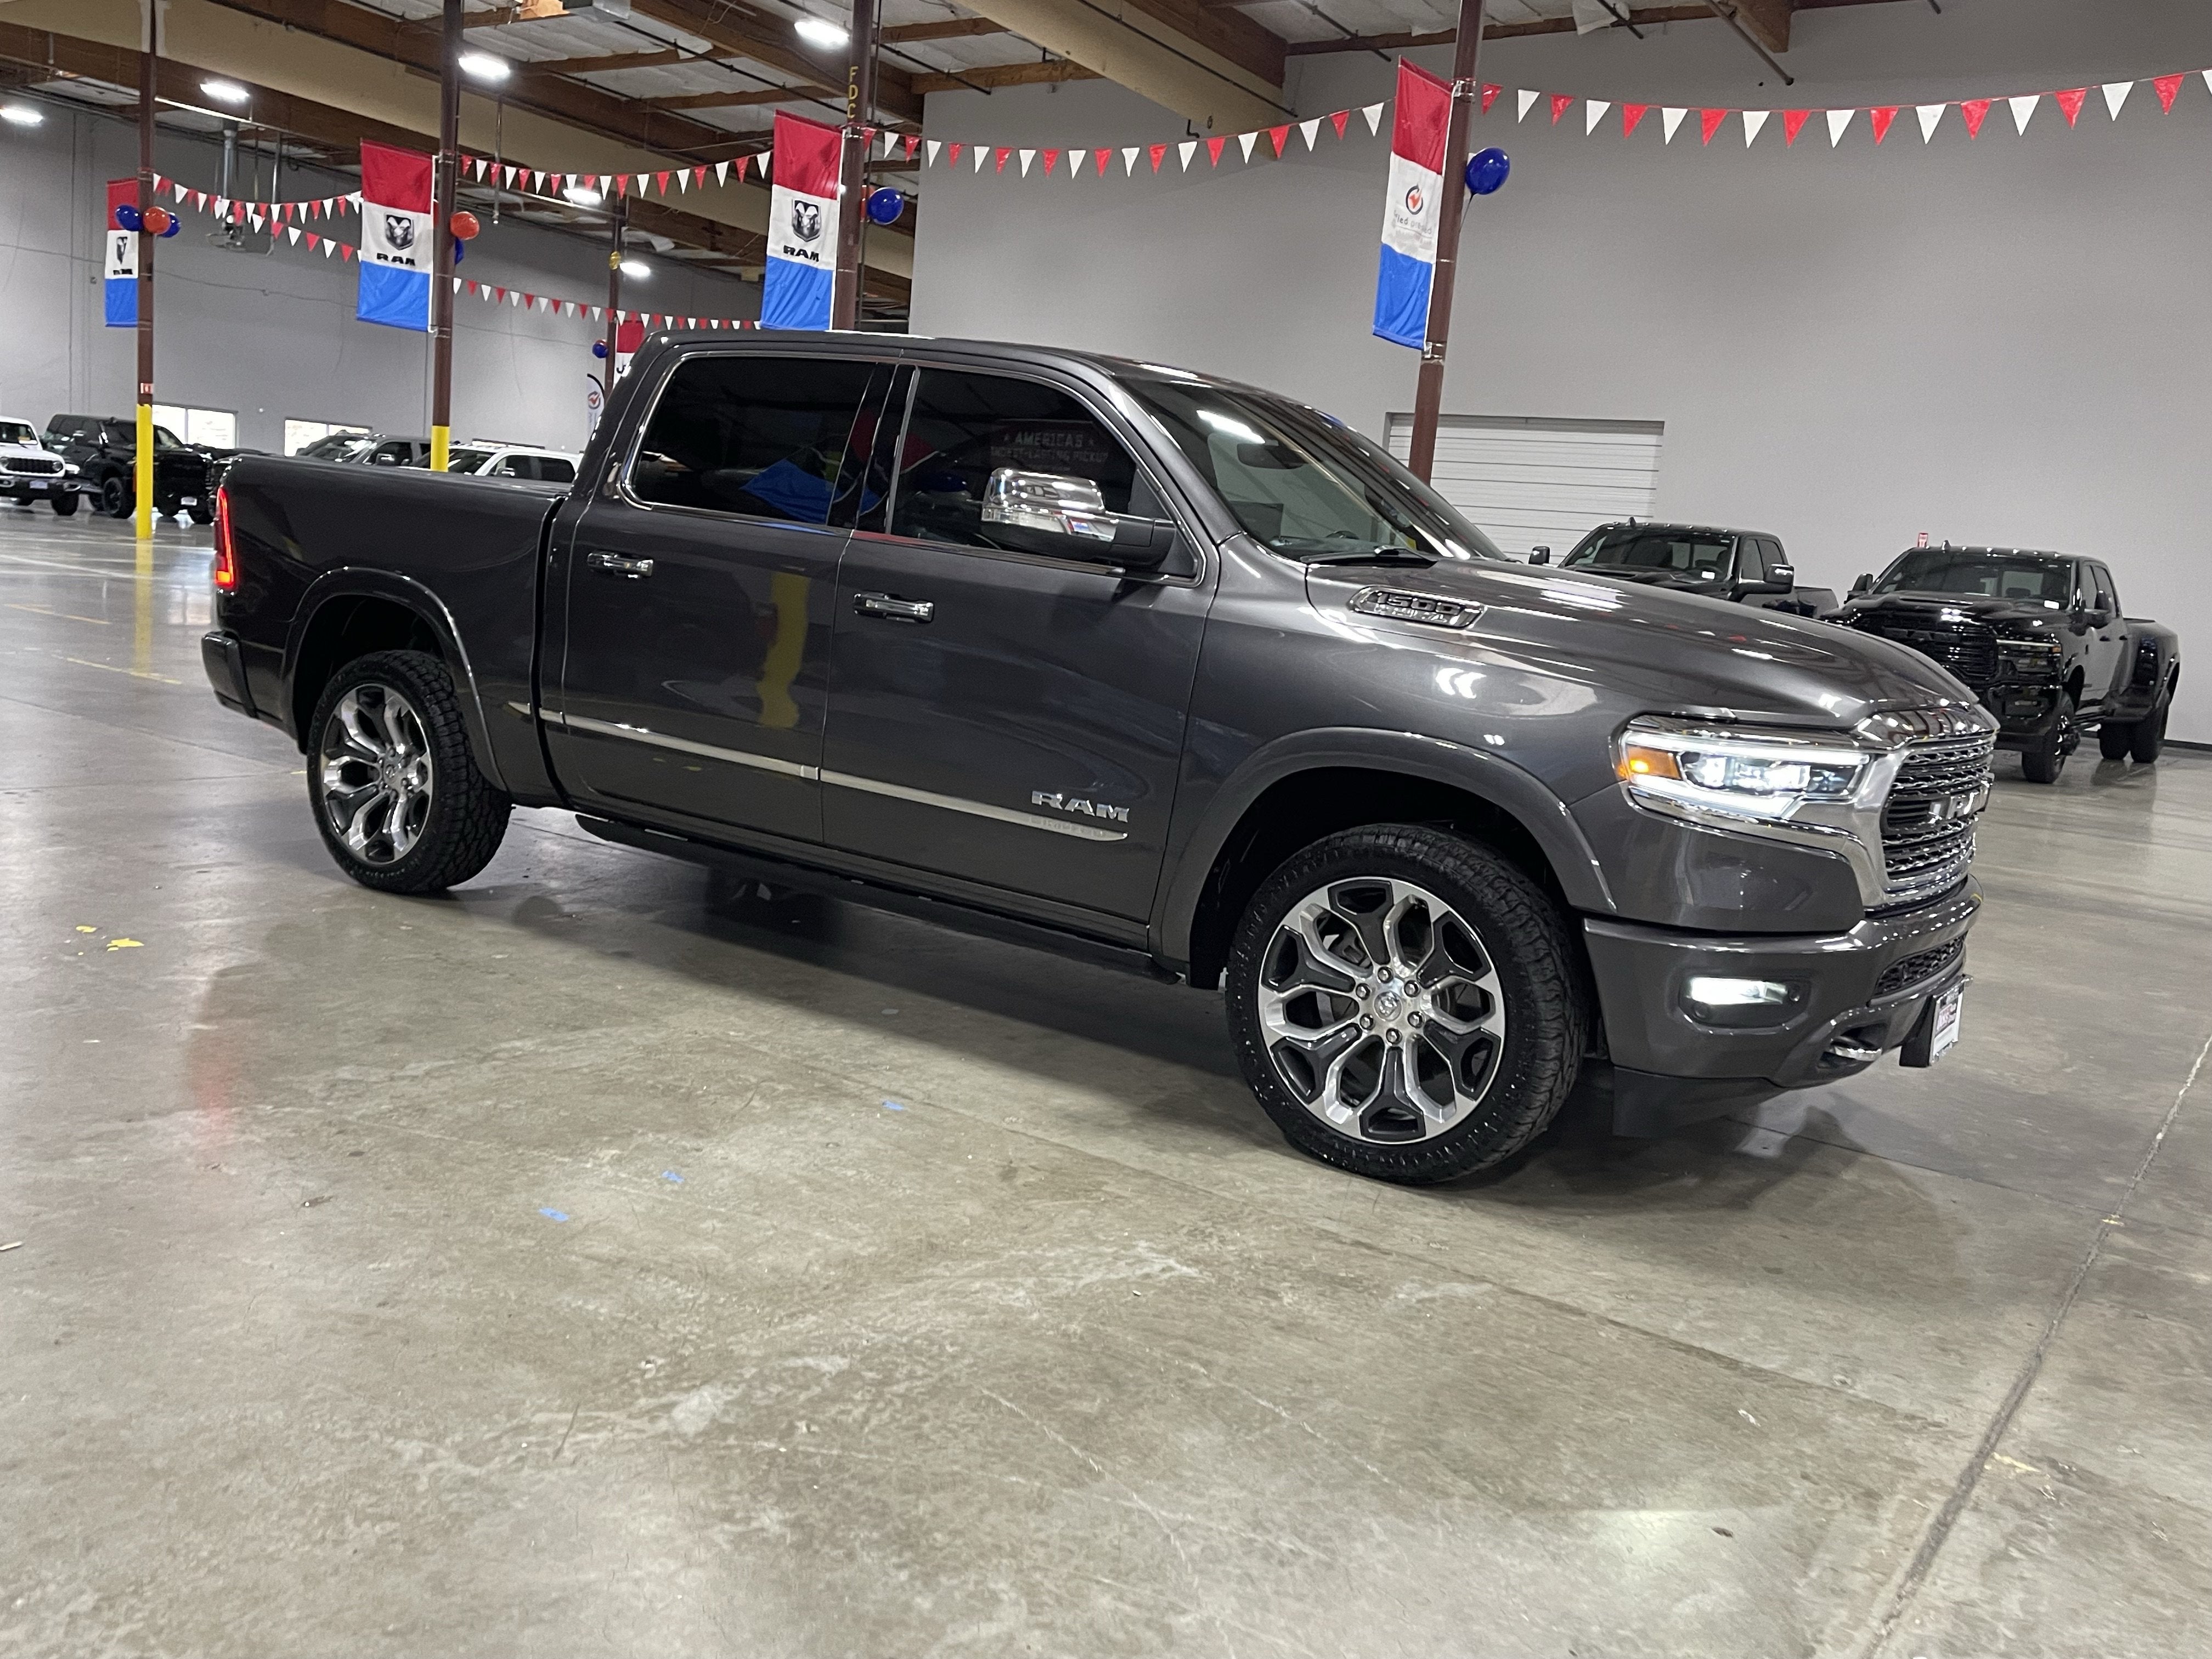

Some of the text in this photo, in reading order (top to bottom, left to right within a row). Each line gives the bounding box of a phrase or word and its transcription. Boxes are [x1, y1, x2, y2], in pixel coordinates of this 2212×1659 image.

[847, 66, 859, 119] FDC
[377, 253, 415, 266] RAM
[783, 245, 819, 262] RAM
[1378, 592, 1460, 615] 1500
[1032, 791, 1130, 822] RAM
